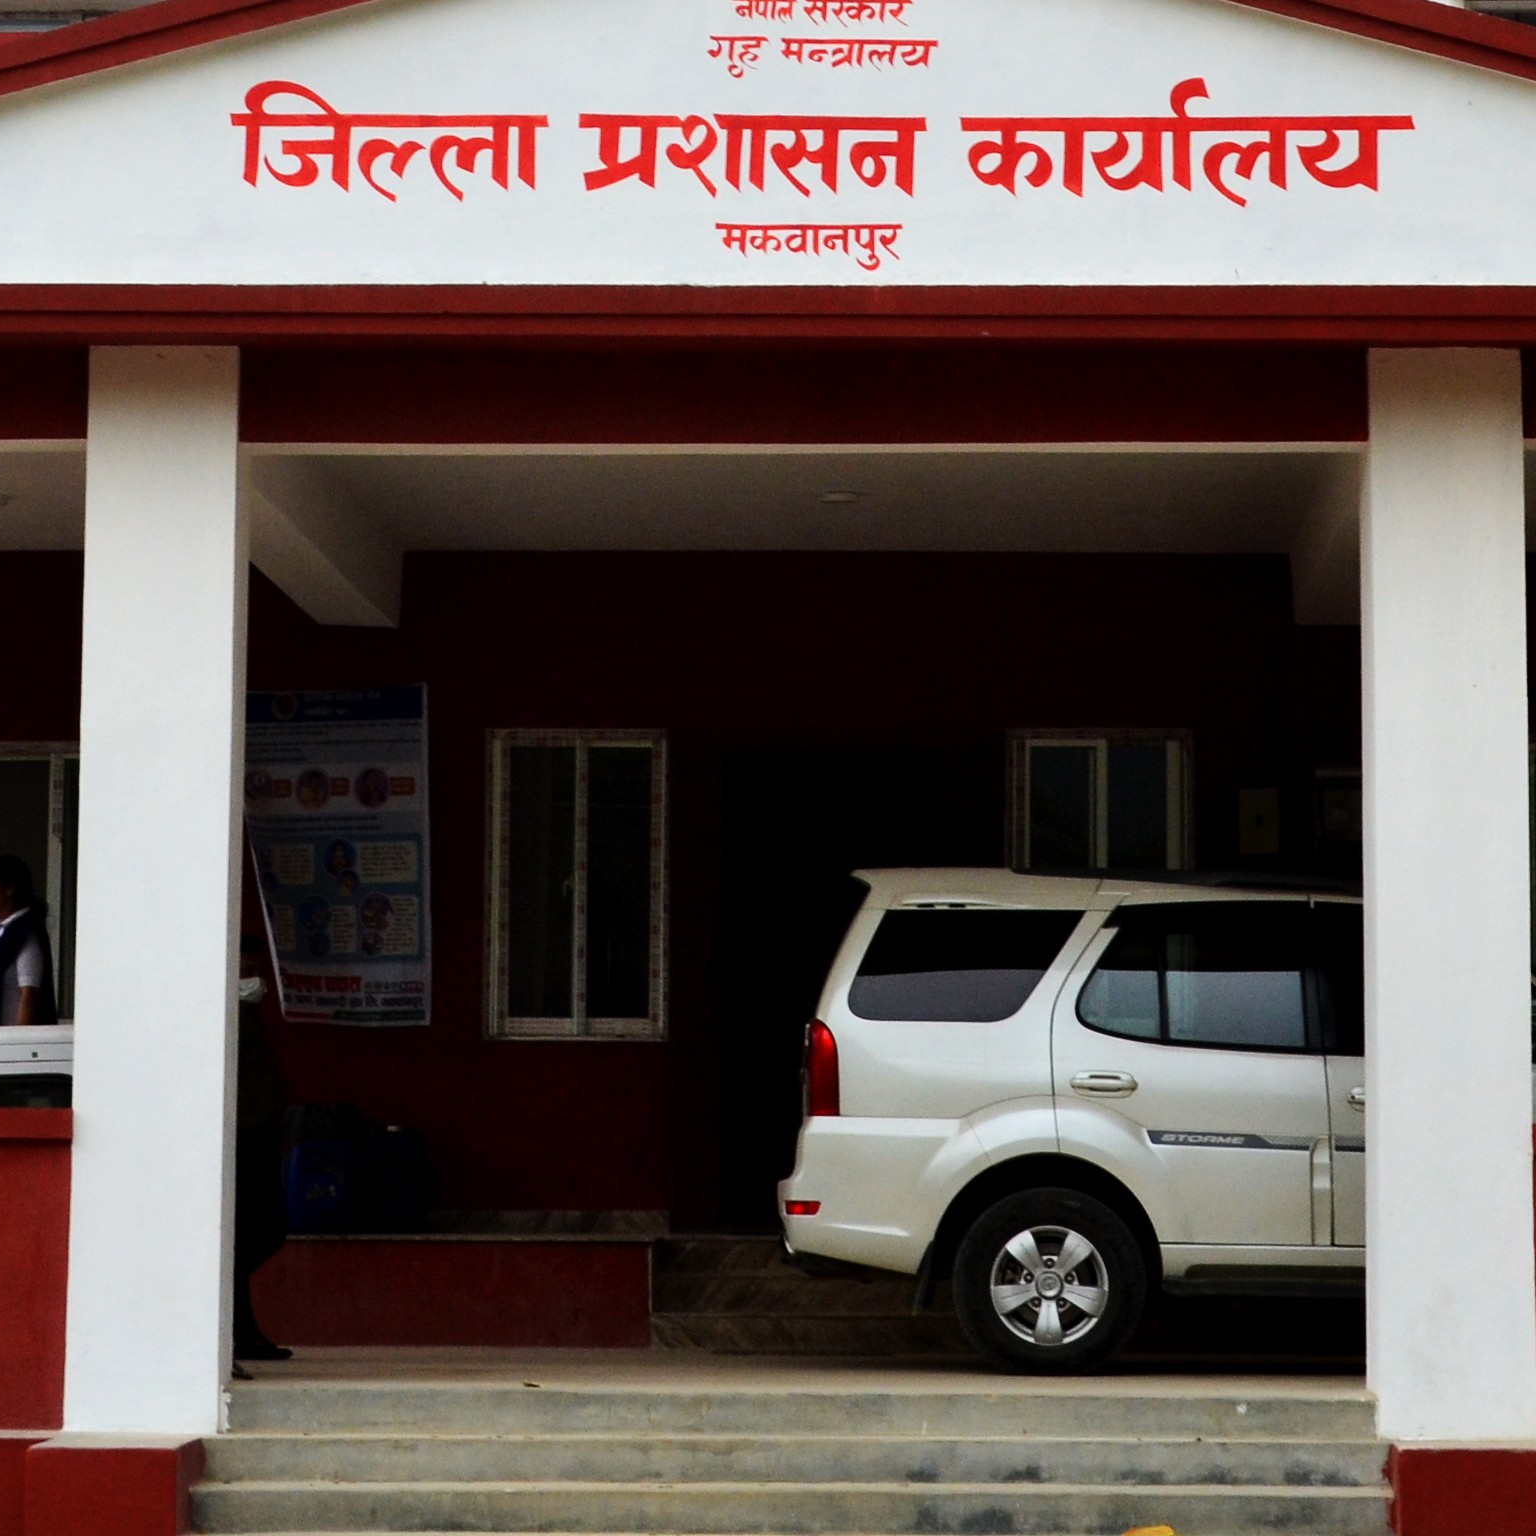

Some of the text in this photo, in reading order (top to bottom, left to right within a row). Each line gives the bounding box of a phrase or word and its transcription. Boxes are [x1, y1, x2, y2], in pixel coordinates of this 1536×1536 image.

[707, 35, 940, 79] गृह मन्त्रालय
[231, 76, 1417, 208] जिल्ला प्रशासन कार्यालय
[714, 222, 904, 272] मकवानपुर
[1160, 1133, 1245, 1145] STORME
